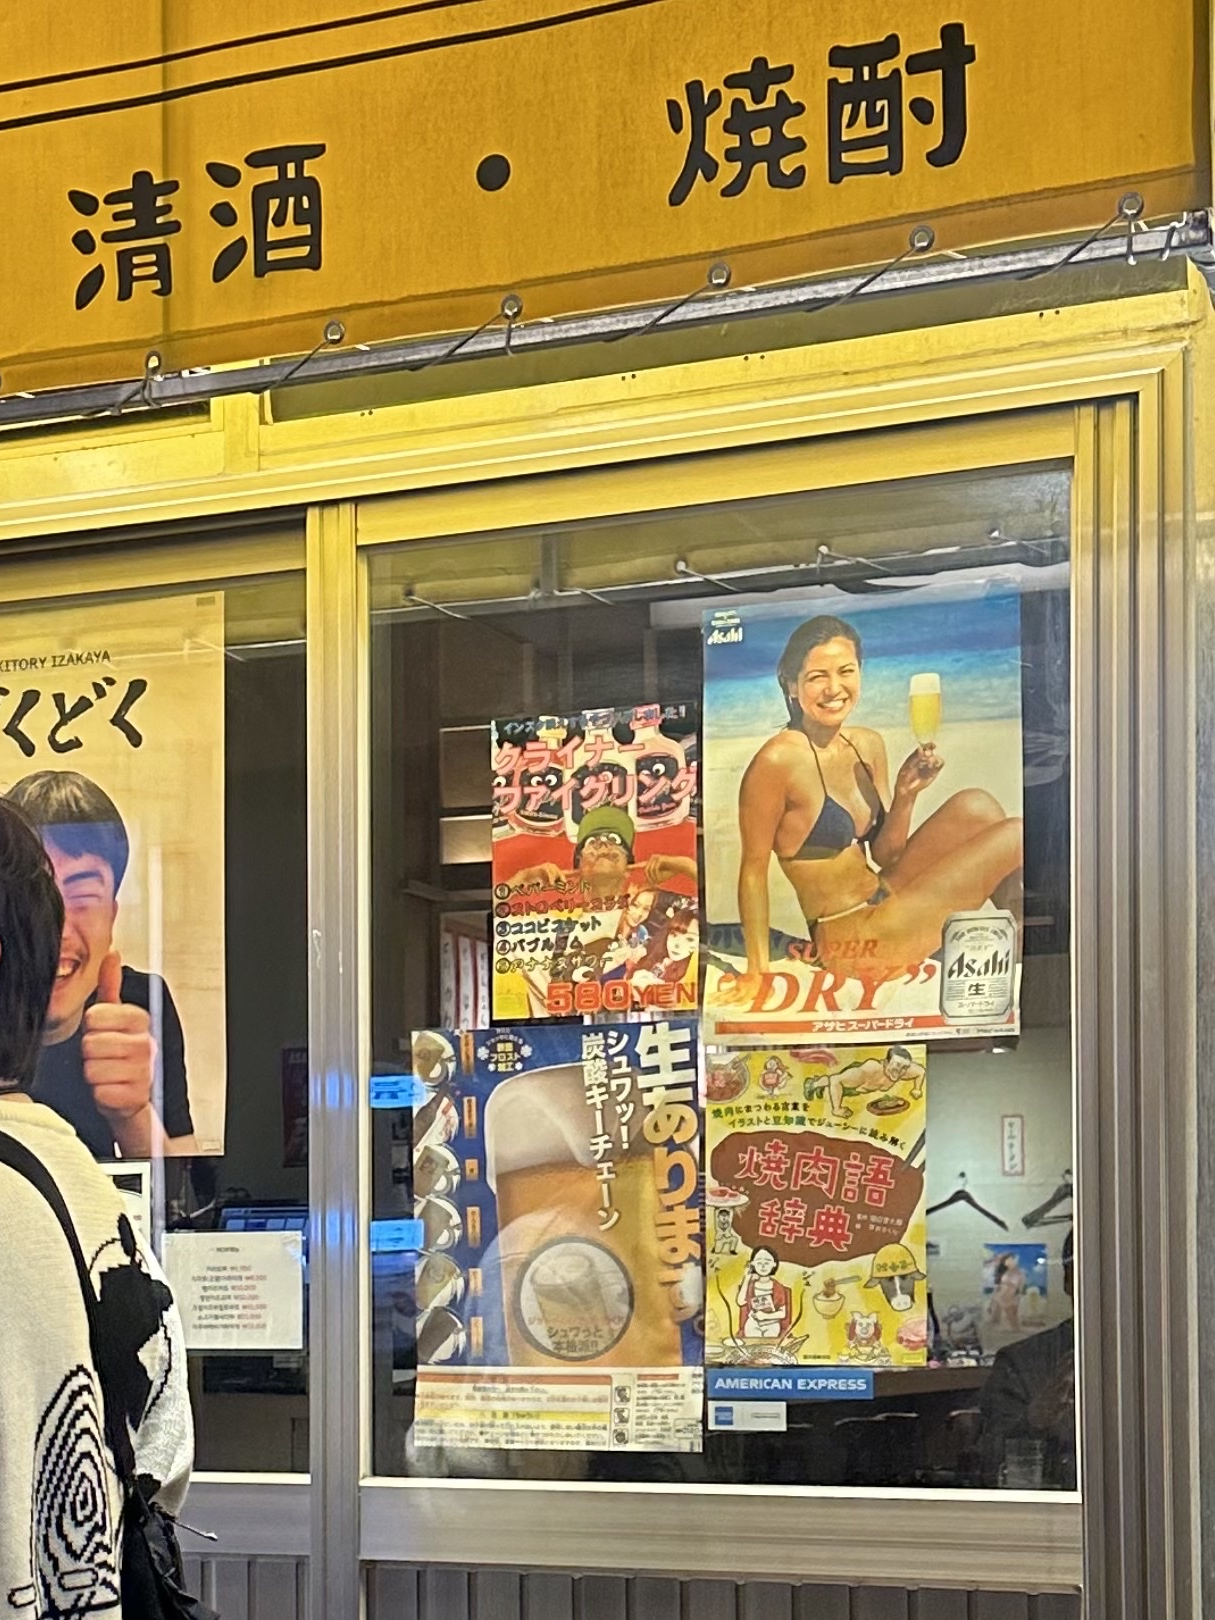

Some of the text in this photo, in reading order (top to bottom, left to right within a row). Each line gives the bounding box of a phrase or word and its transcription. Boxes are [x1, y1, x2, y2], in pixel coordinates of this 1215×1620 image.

[67, 143, 326, 310] 清酒
[665, 22, 977, 207] 焼酎
[51, 649, 111, 669] IZAKAYA
[494, 735, 645, 776] クライナー
[493, 761, 698, 814] ファイグリング
[787, 939, 880, 961] SUPER
[948, 949, 1010, 979] Asahi
[967, 982, 986, 996] 生
[711, 1101, 810, 1119] 焼肉にまつわる言葉を
[581, 1033, 620, 1231] 炭酸キーチェーン
[735, 1138, 896, 1208] 焼肉語
[757, 1196, 853, 1253] 辞典
[714, 1378, 866, 1391] AMERICAN EXPRESS
